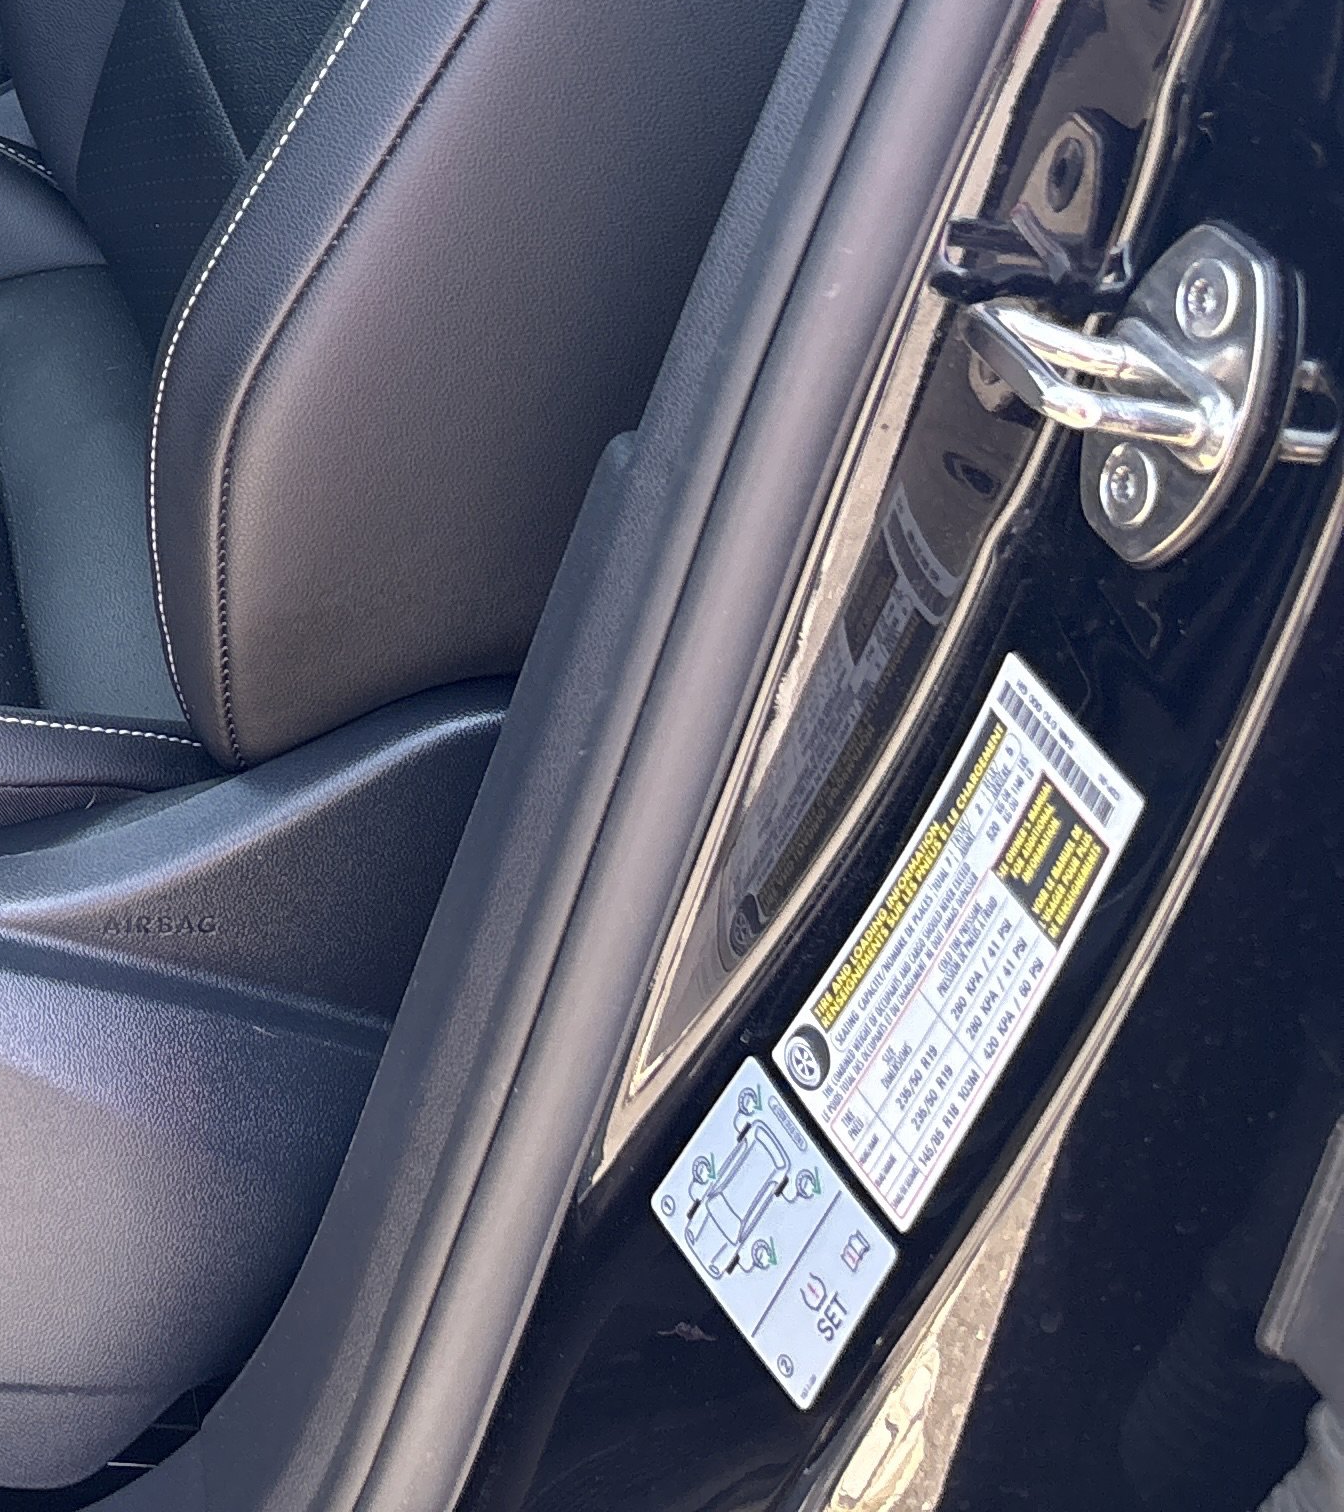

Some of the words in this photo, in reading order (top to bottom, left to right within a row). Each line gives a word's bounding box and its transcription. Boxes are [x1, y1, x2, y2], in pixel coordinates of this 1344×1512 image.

[994, 859, 1011, 882] SEE
[1005, 820, 1031, 864] OWNER'S
[1027, 782, 1052, 822] MANUAL
[1022, 803, 1055, 859] ADDITIONAL
[1061, 856, 1081, 886] POUR
[1075, 832, 1093, 858] PLUS
[821, 926, 889, 1028] RENSEIGNEMENTS
[885, 898, 905, 928] SUR
[901, 877, 918, 903] LES
[914, 838, 942, 882] PNEUS
[938, 822, 951, 841] ET
[945, 805, 961, 828] LE
[956, 723, 1003, 809] CHARGEMENT
[931, 867, 949, 892] TOTAL
[1031, 888, 1050, 914] VOIR
[1051, 839, 1076, 880] MANUEL
[102, 915, 216, 935] AIRBAG
[814, 991, 834, 1021] TIRE
[831, 959, 852, 998] AND
[849, 908, 888, 965] LOADING
[886, 821, 940, 909] INFORMATION
[937, 950, 953, 974] COLD
[958, 900, 983, 938] PRESSURE
[937, 959, 962, 997] PRESSION
[963, 925, 982, 953] PNEUS
[980, 896, 998, 923] FROID
[822, 1082, 835, 1099] THE
[831, 1049, 856, 1086] COMBINED
[852, 1022, 872, 1052] WEIGHT
[875, 976, 902, 1017] OCCUPANTS
[899, 961, 912, 981] AND
[908, 937, 926, 964] CARGO
[922, 910, 943, 941] SHOULD
[939, 888, 956, 913] NEVER
[952, 862, 971, 891] EXCEED
[835, 1010, 860, 1046] SEATING
[858, 936, 908, 1011] CAPACITY/NOMBRE
[904, 923, 916, 939] DE
[911, 894, 934, 926] PLACES
[839, 1072, 857, 1094] TOTAL
[851, 1058, 865, 1076] DES
[861, 1023, 888, 1062] OCCUPANTS
[897, 956, 927, 1006] CHARGEMENT
[930, 929, 945, 951] DOIT
[941, 906, 959, 934] JAMAIS
[950, 996, 967, 1021] 280
[965, 971, 984, 996] KPA
[987, 940, 1000, 958] 41
[997, 918, 1013, 941] PSI
[965, 1015, 983, 1041] 280
[980, 990, 999, 1016] KPA
[1002, 958, 1016, 977] 41
[1012, 937, 1028, 960] PSI
[983, 1036, 1000, 1060] 420
[997, 1010, 1016, 1037] KPA
[1028, 957, 1044, 980] PSI
[881, 1045, 897, 1068] SIZE
[881, 1042, 912, 1089] DIMENSIONS
[895, 1069, 923, 1111] 235/50
[920, 1045, 938, 1070] R19
[848, 1116, 865, 1141] PNEU
[911, 1089, 938, 1131] 235/50
[935, 1064, 953, 1090] R19
[817, 1291, 847, 1342] SET
